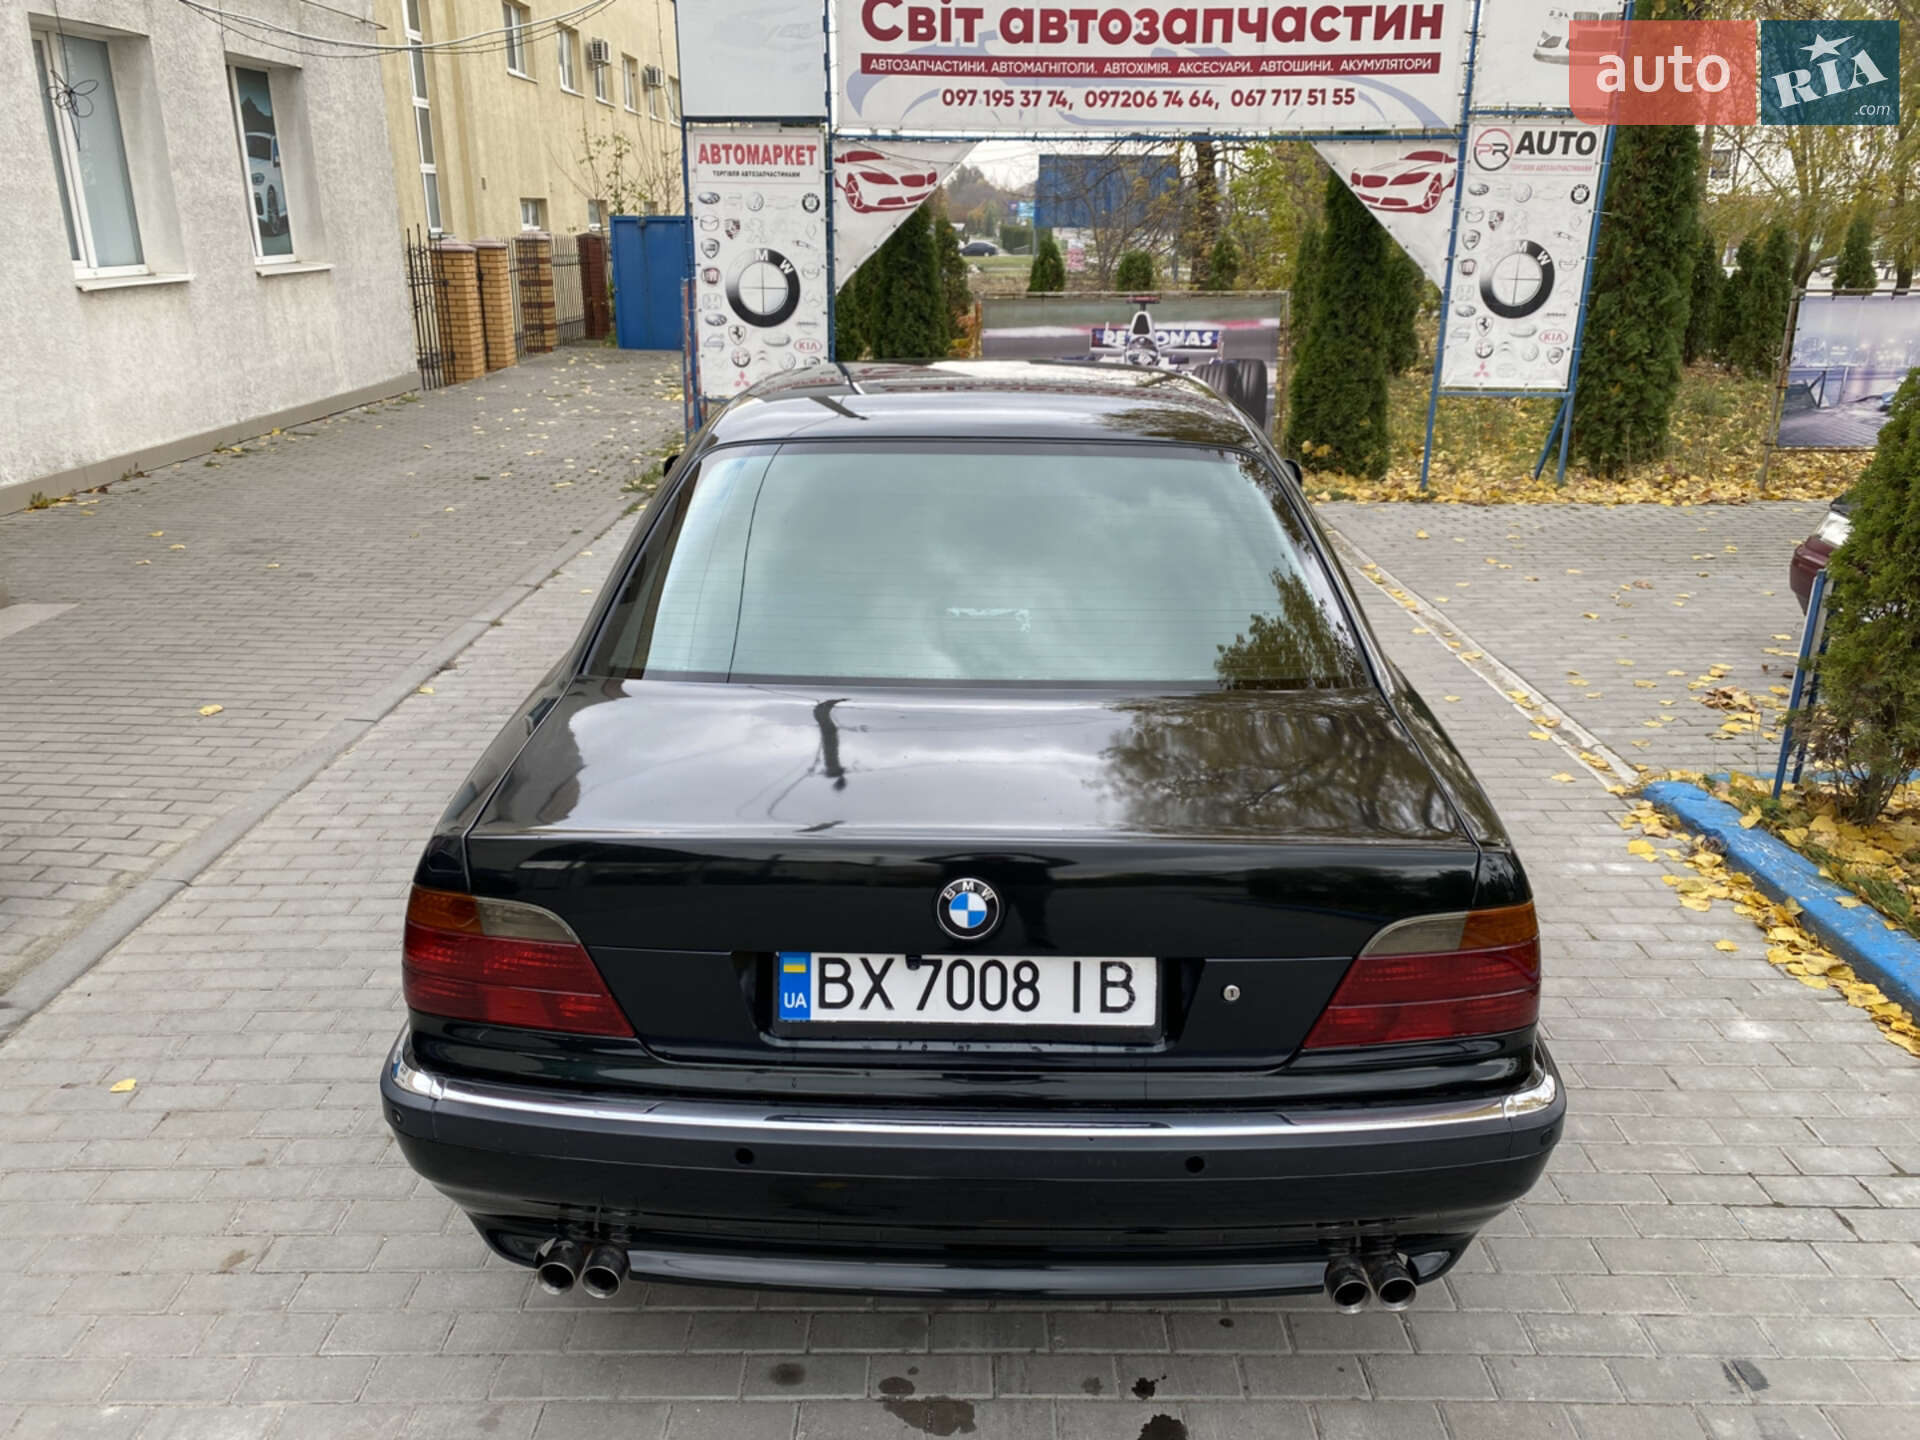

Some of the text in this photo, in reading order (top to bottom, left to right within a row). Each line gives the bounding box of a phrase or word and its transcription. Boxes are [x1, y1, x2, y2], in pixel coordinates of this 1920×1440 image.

[861, 0, 1444, 45] Світ автозапчастин
[870, 58, 1432, 75] АВТОЗАПЧАСТИНИ. АВТОМАГНІТОЛИ. АВТОХІМІЯ. АКСЕСУАРИ. АВТОШИНИ. АКУМУЛЯТОРИ
[942, 88, 978, 106] 097
[982, 89, 1015, 107] 195
[1020, 90, 1042, 108] 37
[1162, 90, 1184, 108] 74
[1231, 89, 1267, 107] 067
[1271, 88, 1302, 107] 717
[1306, 88, 1327, 106] 51
[1332, 88, 1356, 106] 55
[1515, 130, 1598, 156] AUTO
[698, 143, 817, 166] АВТОМАРКЕТ
[1103, 329, 1214, 347] PEONAS
[943, 880, 995, 901] BMW
[818, 956, 1137, 1015] BX 7008 IB
[783, 992, 808, 1009] UA
